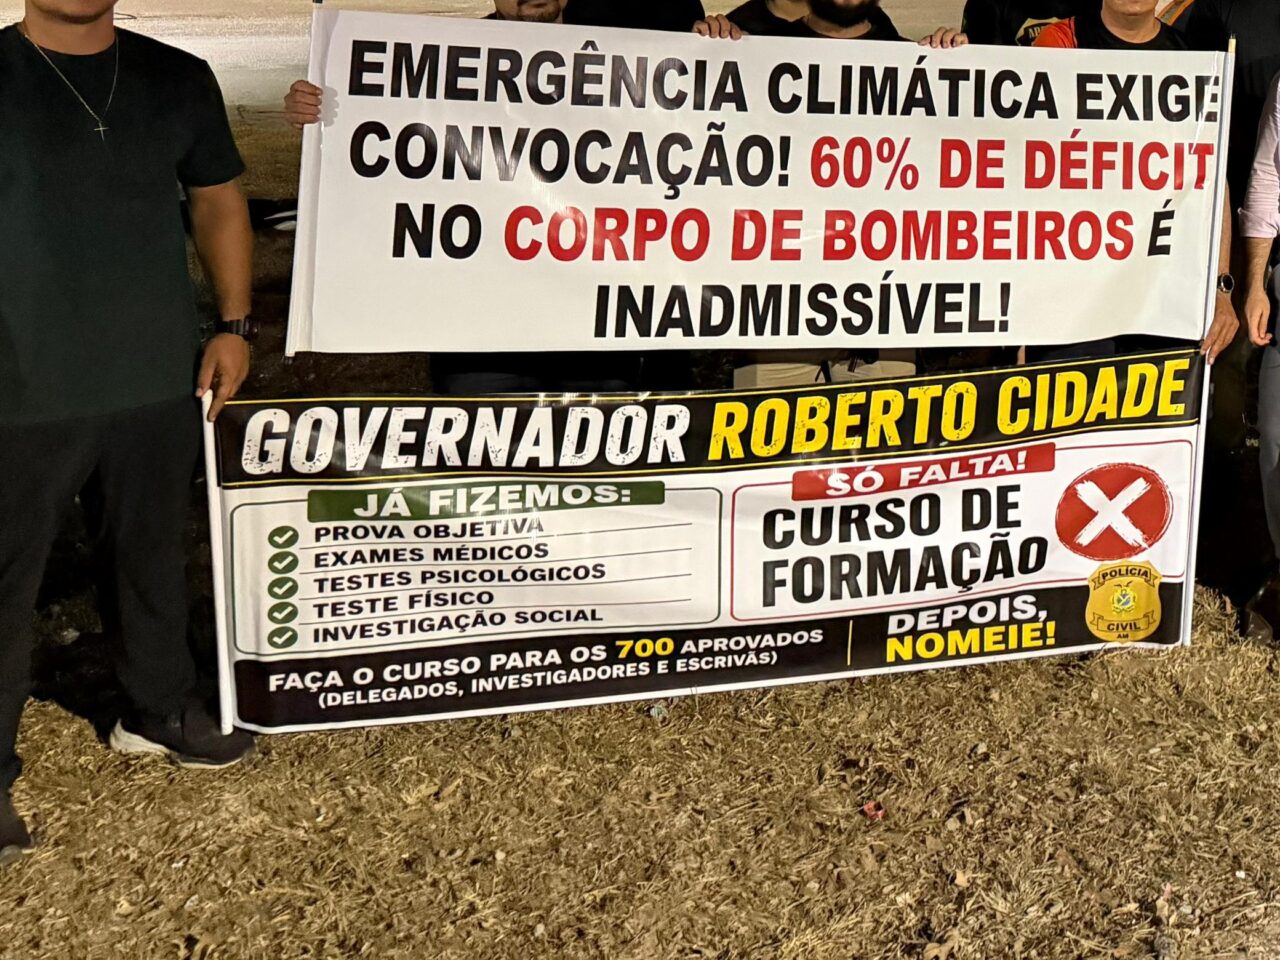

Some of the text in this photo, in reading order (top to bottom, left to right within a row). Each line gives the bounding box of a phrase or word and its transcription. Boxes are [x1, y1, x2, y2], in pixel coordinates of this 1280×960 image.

[348, 40, 1220, 123] EMERGÊNCIA CLIMÁTICA EXIGE
[349, 120, 1215, 200] CONVOCAÇÃO! 60% DE DÉFICIT
[391, 198, 1176, 262] NO CORPO DE BOMBEIROS É
[593, 269, 1012, 339] INADMISSÍVEL!
[241, 358, 1191, 476] GOVERNADOR ROBERTO CIDADE
[825, 451, 1027, 497] SÓ FALTA!
[353, 483, 632, 518] JÁ FIZEMOS:
[762, 484, 1022, 550] CURSO DE
[314, 516, 545, 543] PROVA OBJETIVA
[314, 542, 550, 569] EXAMES MÉDICOS
[762, 531, 1049, 608] FORMAÇÃO
[1101, 566, 1149, 581] POLÍCIA
[313, 563, 607, 594] TESTES PSICOLÓGICOS
[313, 590, 495, 619] TESTE FÍSICO
[313, 608, 604, 644] INVESTIGAÇÃO SOCIAL
[887, 594, 1048, 636] DEPOIS,
[1106, 621, 1142, 632] CIVIL
[268, 629, 824, 694] FAÇA O CURSO PARA OS 700 APROVADOS
[886, 620, 1057, 663] NOMEIE!
[318, 651, 778, 709] (DELEGADOS, INVESTIGADORES E ESCRIVÃS)
